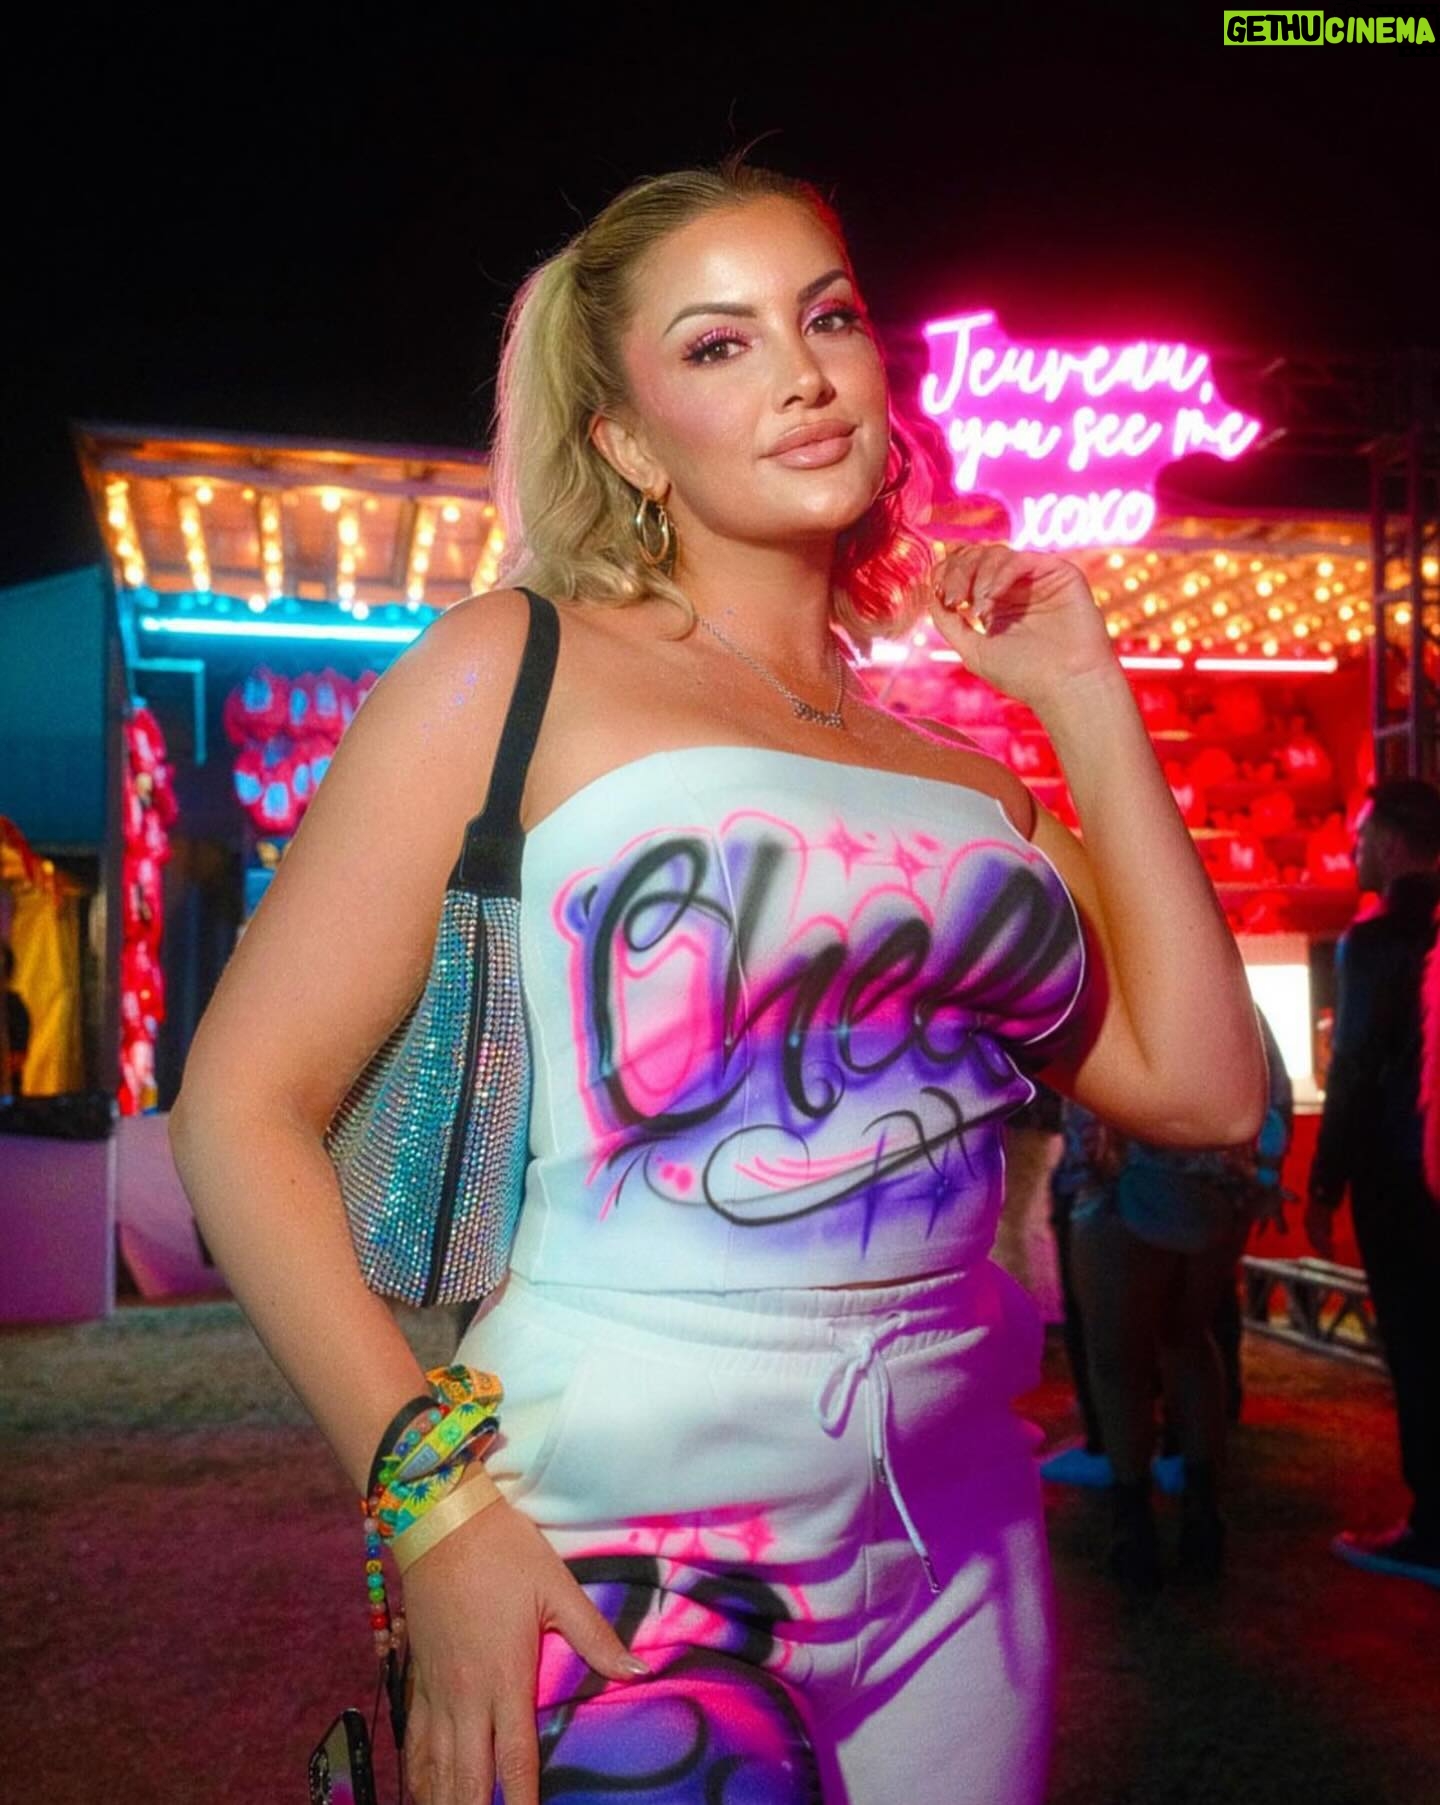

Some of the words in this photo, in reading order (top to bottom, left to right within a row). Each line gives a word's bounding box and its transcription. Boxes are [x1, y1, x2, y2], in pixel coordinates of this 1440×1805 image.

[949, 416, 1062, 491] you
[1068, 406, 1162, 471] see
[1172, 408, 1259, 457] me
